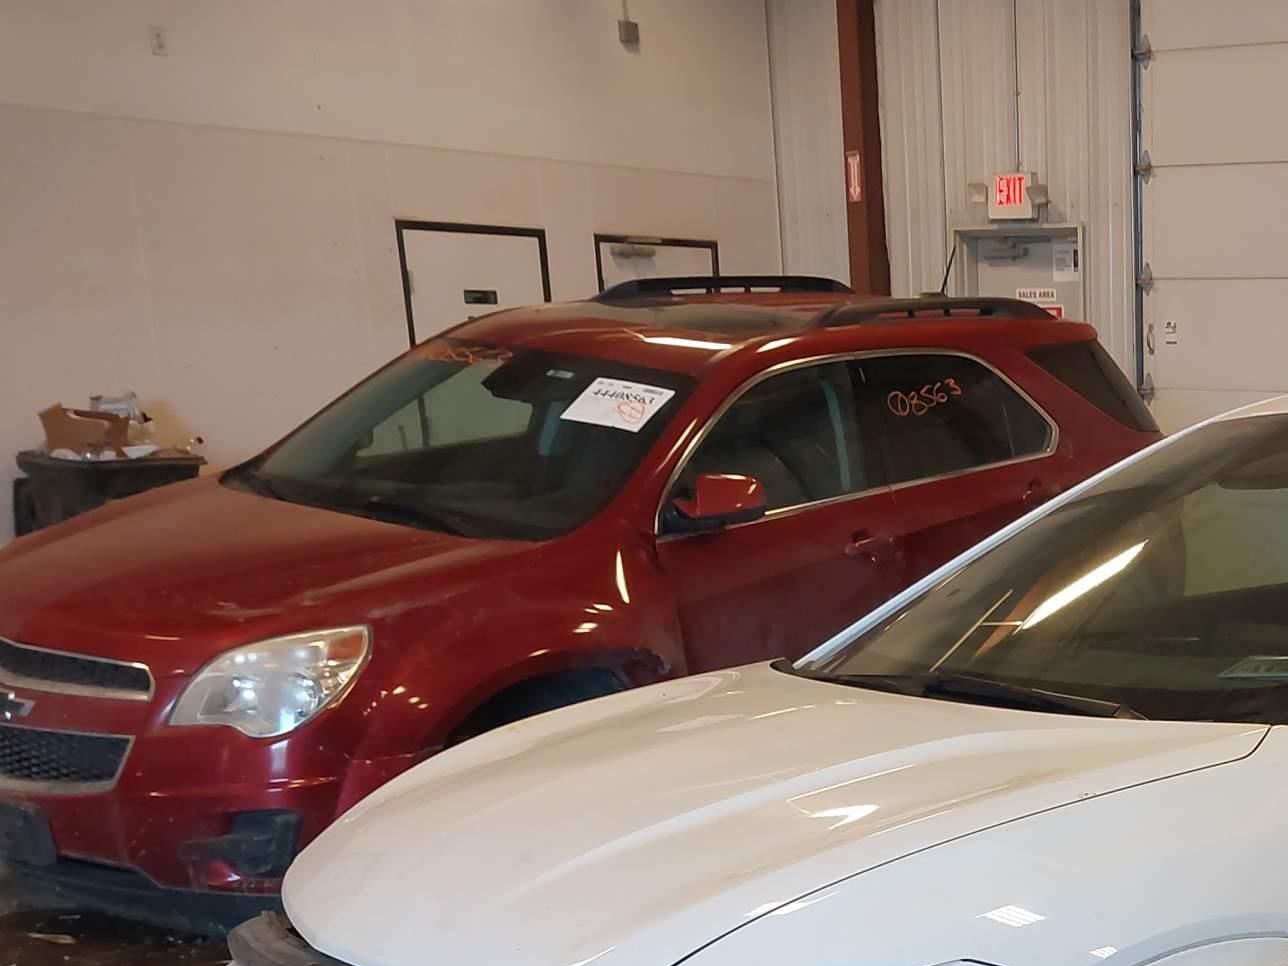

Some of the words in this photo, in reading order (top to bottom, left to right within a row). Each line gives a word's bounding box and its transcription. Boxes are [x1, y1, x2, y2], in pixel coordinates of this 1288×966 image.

[997, 176, 1025, 206] EXIT
[1018, 291, 1037, 299] SALES
[591, 388, 655, 405] 44408563
